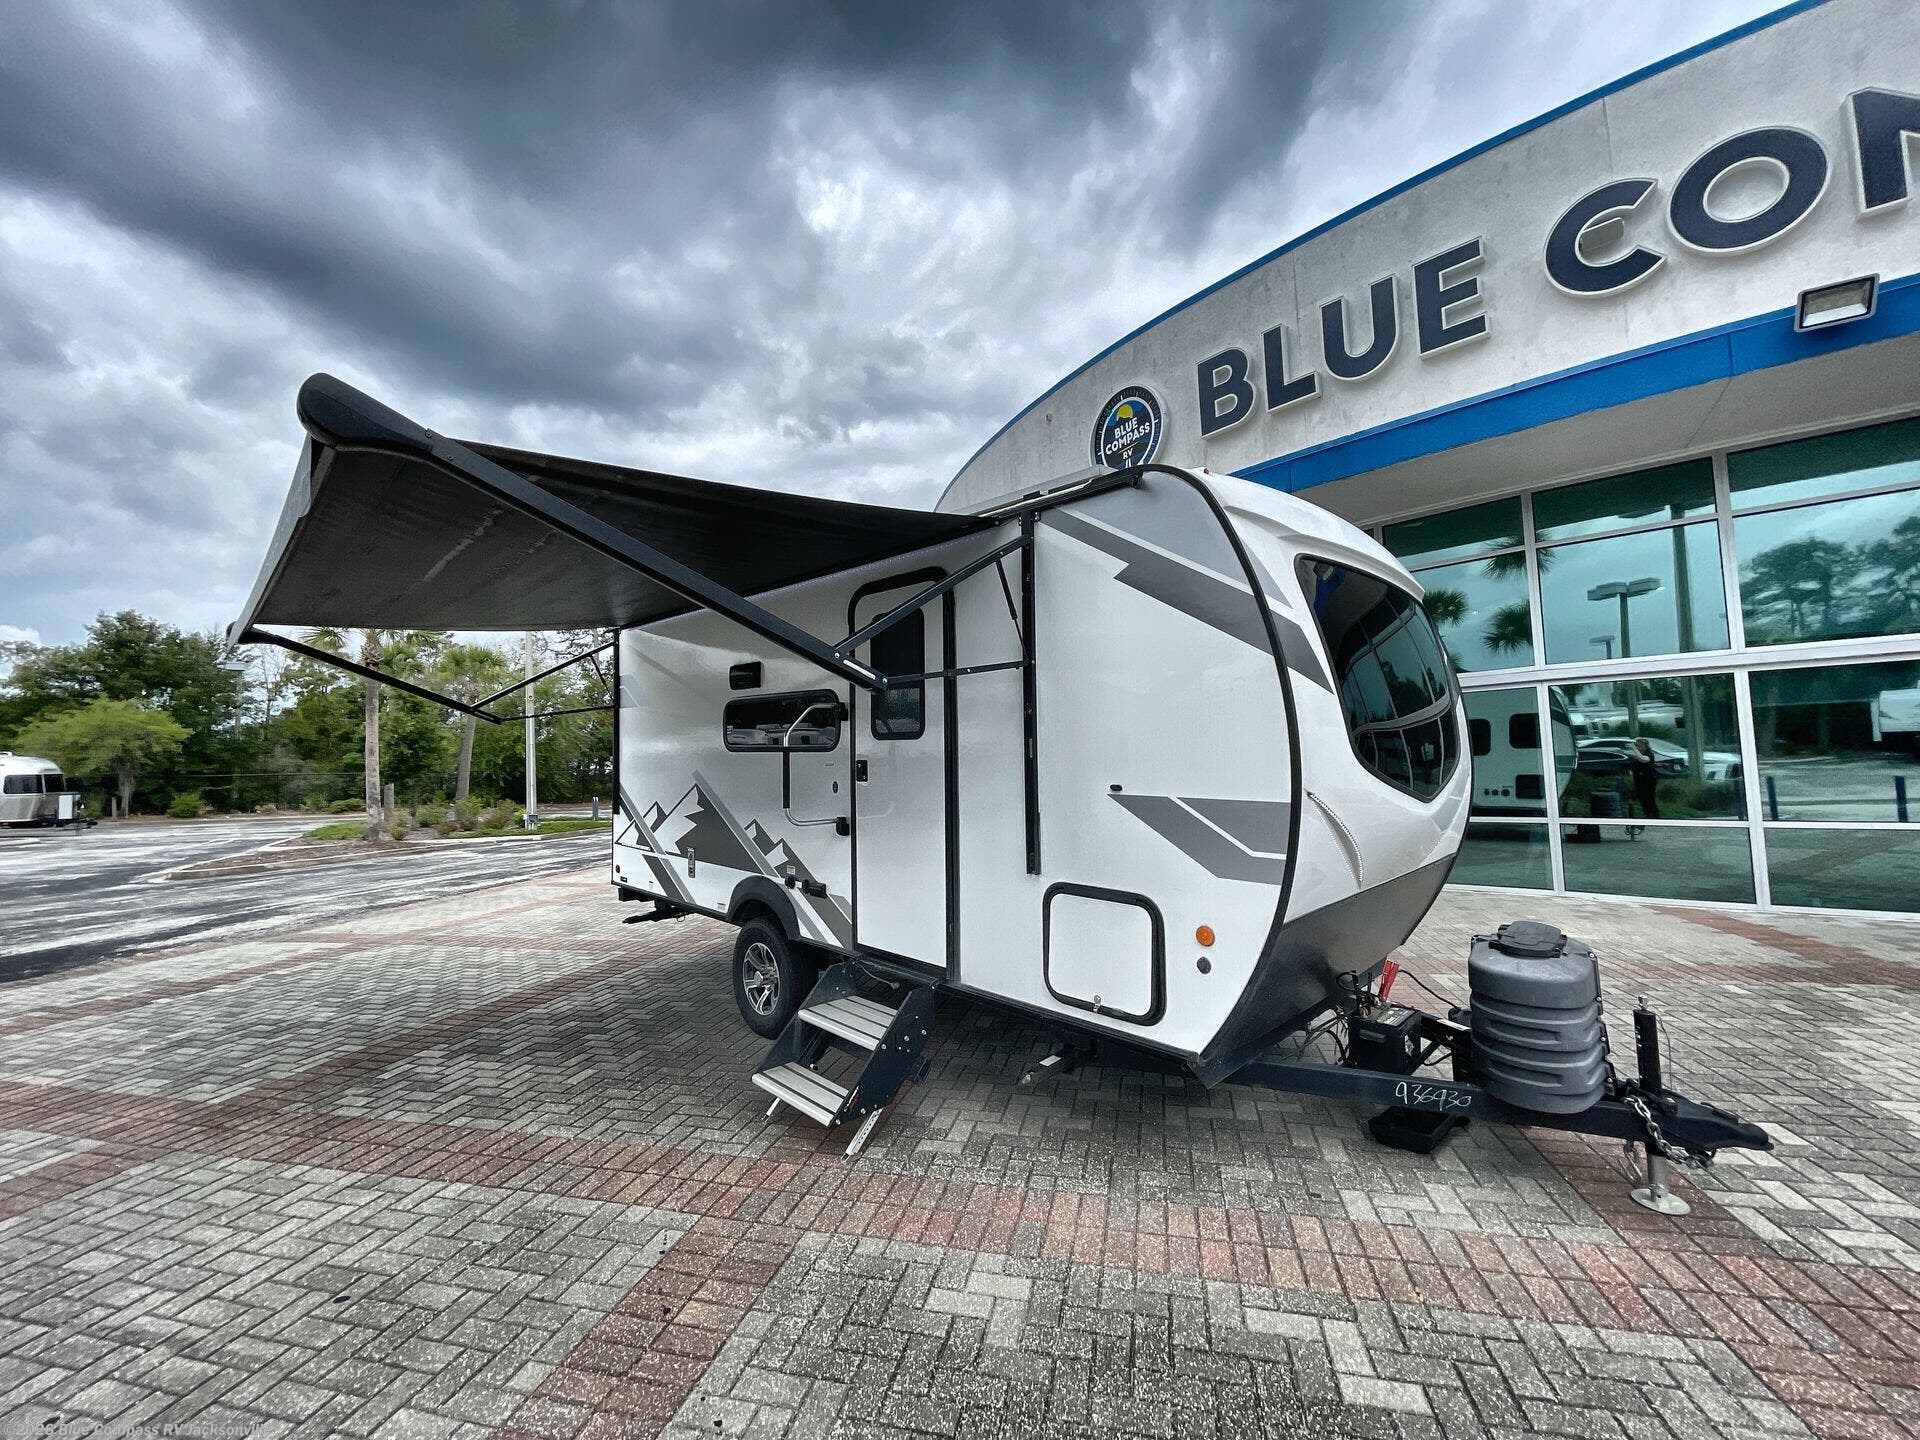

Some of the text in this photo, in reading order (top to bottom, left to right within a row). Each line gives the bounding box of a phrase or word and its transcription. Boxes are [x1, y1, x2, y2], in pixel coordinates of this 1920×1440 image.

[1198, 236, 1490, 438] BLUE
[1105, 422, 1150, 455] COMPASS
[1114, 417, 1138, 439] BLUE
[1122, 447, 1133, 459] RV
[1395, 1081, 1472, 1111] 936930
